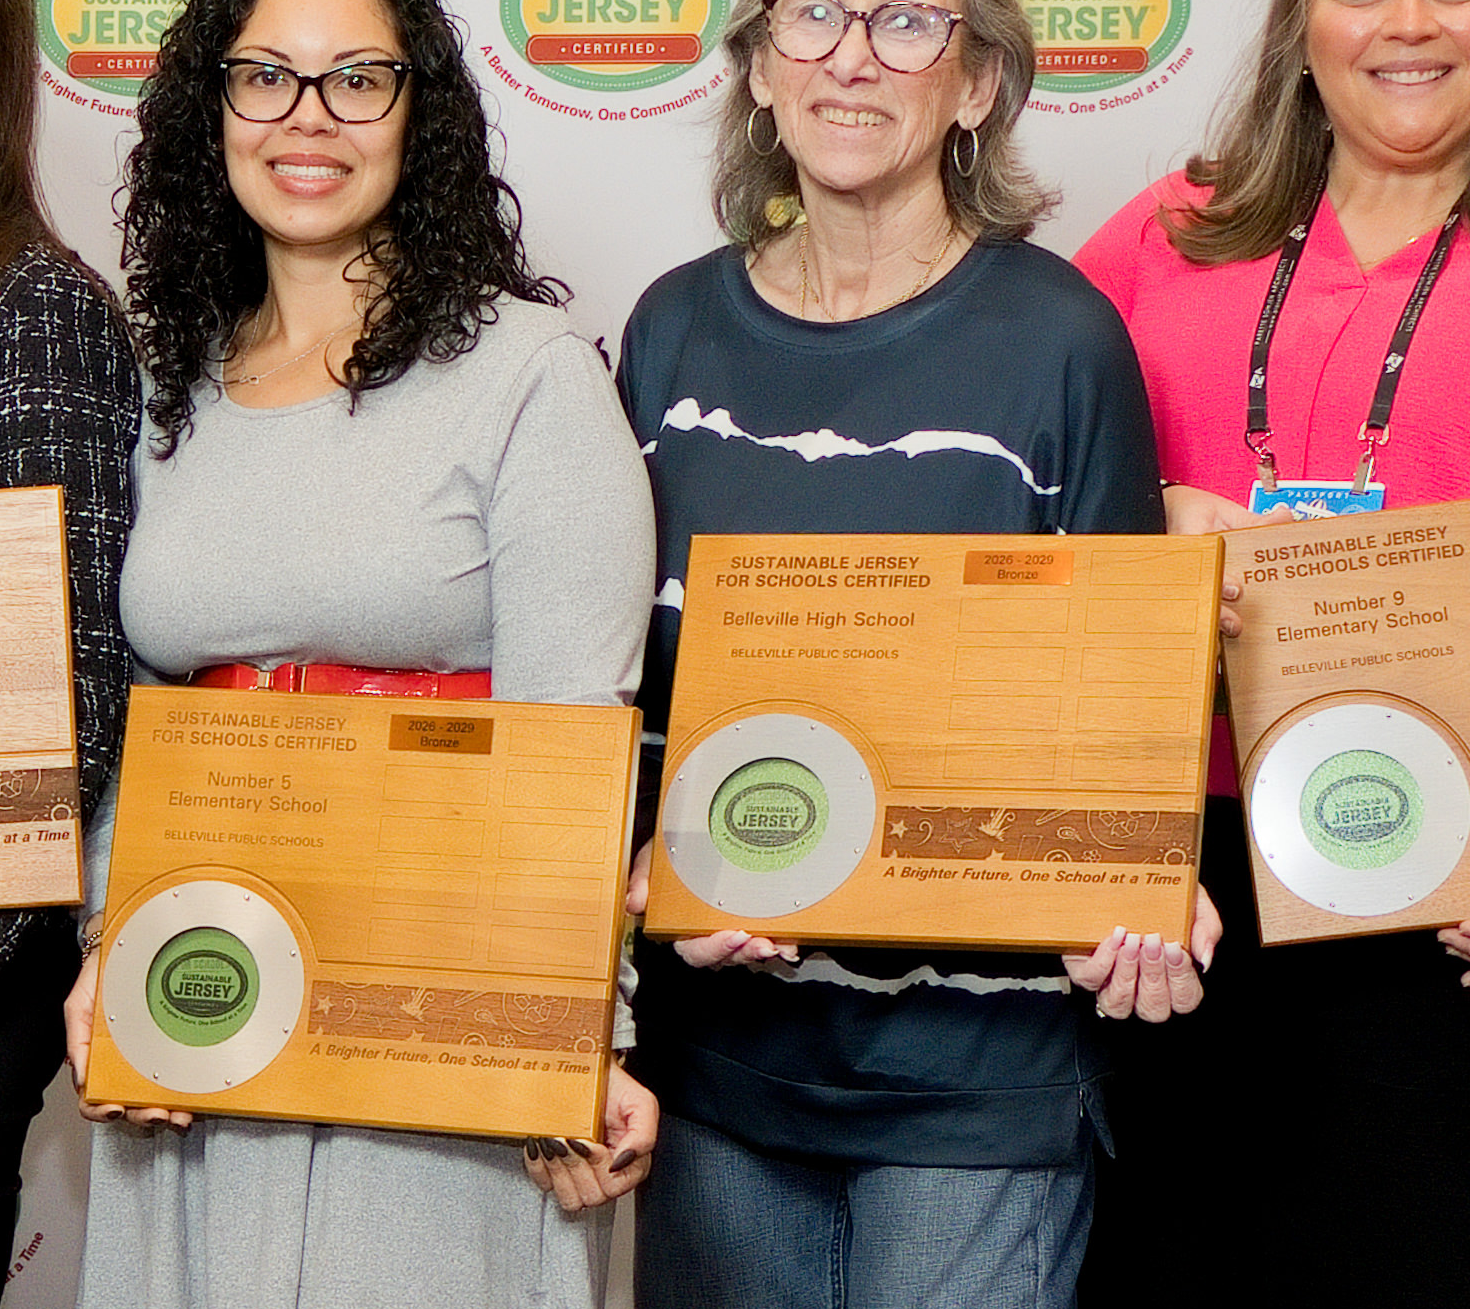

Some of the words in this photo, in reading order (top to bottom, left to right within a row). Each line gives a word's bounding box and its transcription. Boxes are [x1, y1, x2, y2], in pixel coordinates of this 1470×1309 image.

[1288, 490, 1350, 499] PASSPORT
[1253, 535, 1377, 564] SUSTAINABLE
[1381, 525, 1449, 546] JERSEY
[730, 557, 849, 568] SUSTAINABLE
[854, 557, 919, 568] JERSEY
[1243, 568, 1278, 584] FOR
[1284, 556, 1369, 579] SCHOOLS
[1375, 543, 1465, 567] CERTIFIED
[715, 575, 749, 587] FOR
[755, 575, 837, 587] SCHOOLS
[844, 575, 931, 587] CERTIFIED
[1313, 596, 1384, 616] Number
[1392, 590, 1405, 605] 9
[722, 612, 799, 625] Belleville
[806, 612, 846, 628] High
[853, 612, 915, 626] School
[1276, 618, 1377, 642] Elementary
[1385, 607, 1448, 628] School
[165, 712, 280, 727] SUSTAINABLE
[284, 716, 347, 730] JERSEY
[151, 731, 183, 744] FOR
[189, 732, 268, 747] SCHOOLS
[274, 735, 358, 750] CERTIFIED
[207, 772, 274, 789] Number
[280, 774, 292, 790] 5
[167, 792, 262, 814] Elementary
[268, 796, 327, 813] School
